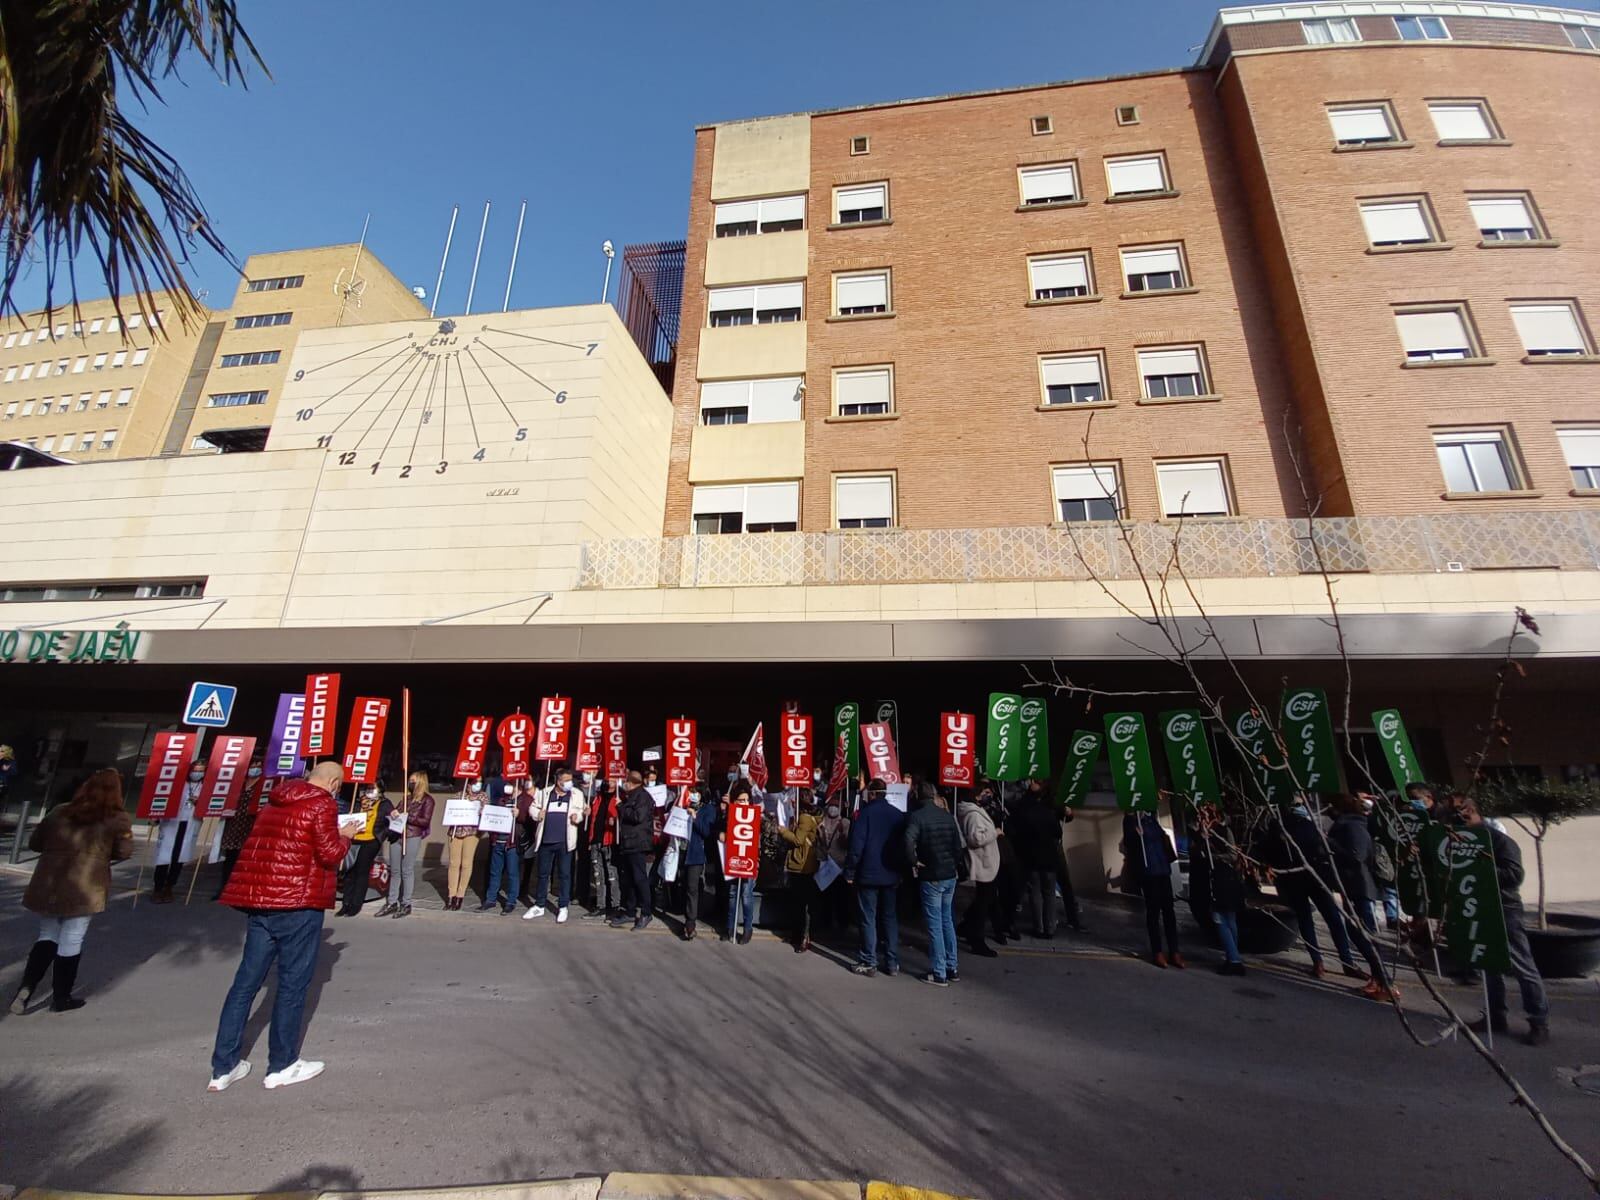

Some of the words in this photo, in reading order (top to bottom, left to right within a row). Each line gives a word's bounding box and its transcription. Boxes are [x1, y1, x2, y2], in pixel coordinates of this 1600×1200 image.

[430, 336, 458, 346] CHJ
[584, 344, 598, 356] 7
[294, 369, 306, 382] 9
[555, 390, 568, 404] 6
[296, 408, 314, 422] 10
[515, 428, 528, 441] 5
[316, 434, 333, 448] 11
[338, 452, 357, 466] 12
[473, 448, 486, 461] 4
[370, 462, 381, 475] 1
[400, 465, 412, 478] 2
[435, 461, 448, 474] 3
[28, 630, 64, 660] DE
[68, 620, 140, 660] JAÉN
[280, 697, 306, 754] CCOO
[310, 676, 328, 733] CCOO
[545, 701, 566, 742] UGT
[356, 700, 380, 760] CCOO
[466, 720, 488, 760] UGT
[510, 720, 526, 761] UGT
[584, 712, 603, 752] UGT
[609, 717, 623, 760] UGT
[672, 723, 690, 767] UGT
[787, 719, 807, 766] UGT
[866, 727, 890, 772] UGT
[946, 716, 968, 765] UGT
[997, 723, 1010, 777] CSIF
[1027, 725, 1039, 776] CSIF
[155, 736, 186, 795] CCOO
[212, 738, 244, 795] CCOO
[1124, 745, 1142, 807] CSIF
[1182, 744, 1204, 806] CSIF
[1301, 723, 1320, 788] CSIF
[1394, 740, 1410, 783] CSI
[1064, 758, 1087, 804] CSIF
[733, 807, 755, 857] UGT
[1459, 874, 1488, 963] CSIF
